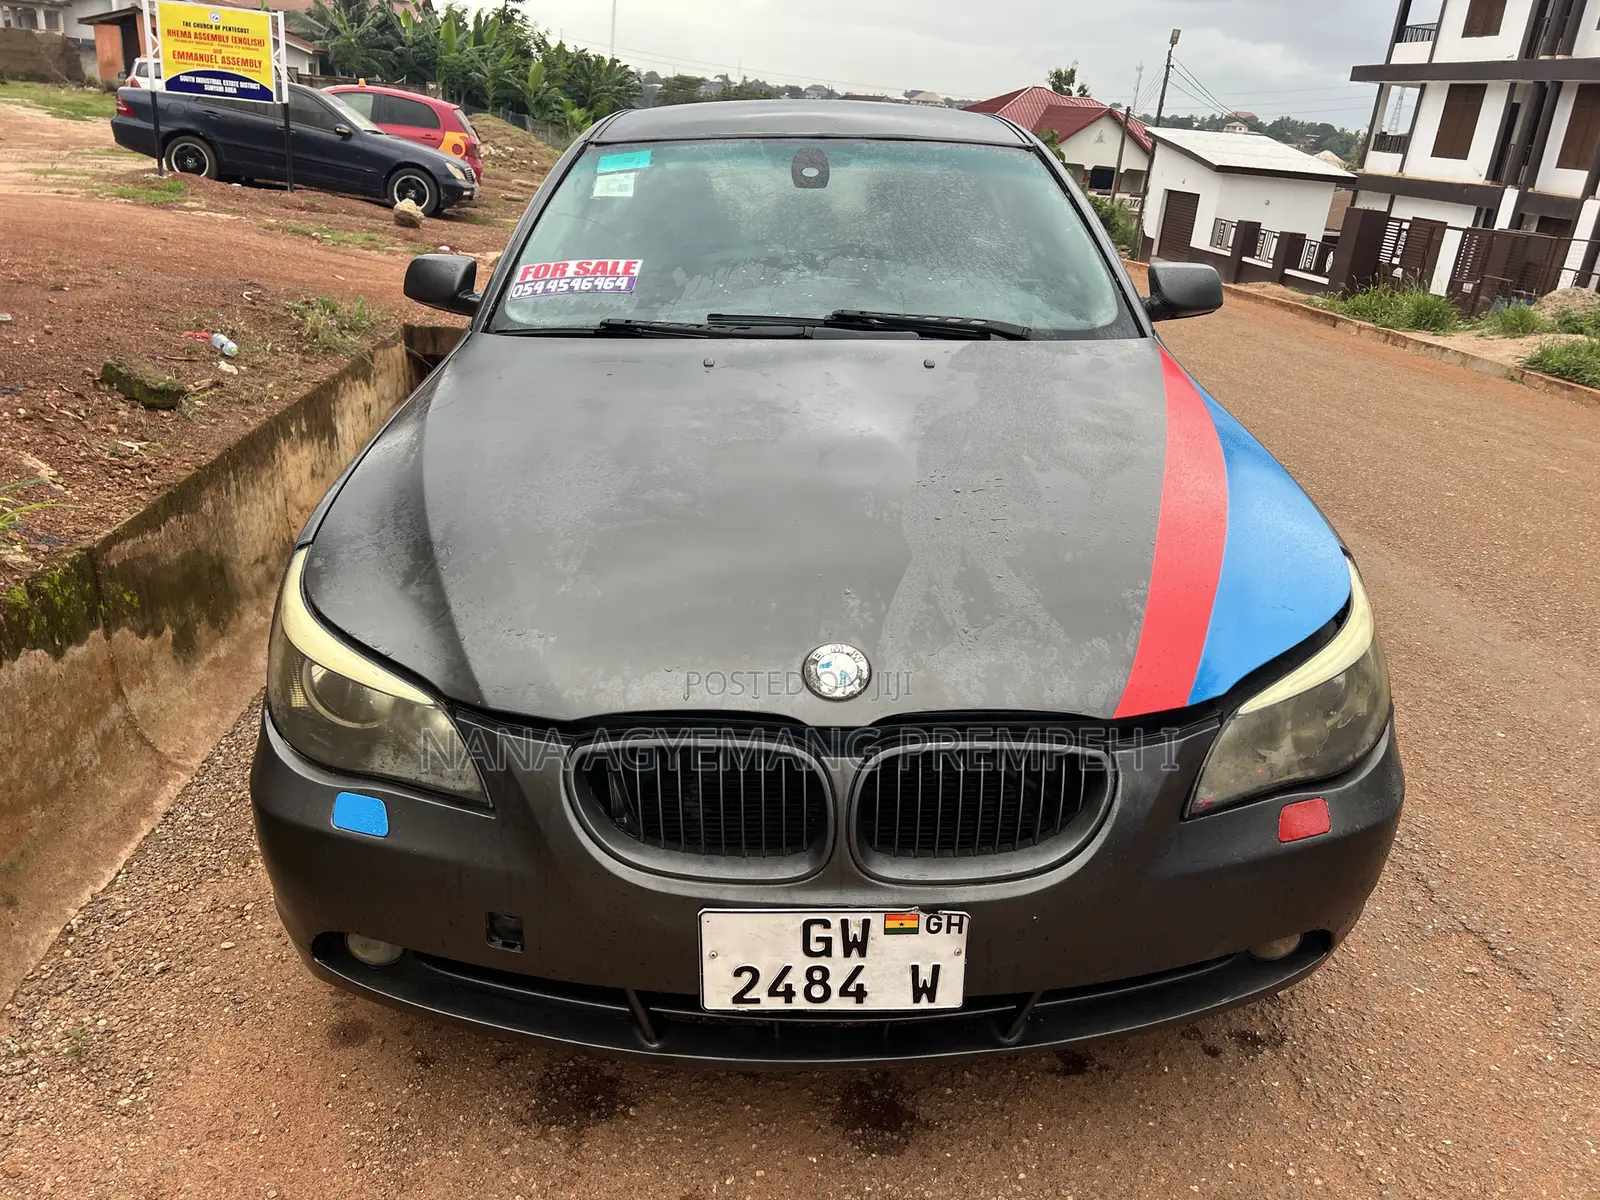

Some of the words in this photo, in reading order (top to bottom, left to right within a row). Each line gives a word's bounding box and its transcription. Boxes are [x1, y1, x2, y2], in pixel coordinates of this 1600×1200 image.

[166, 28, 192, 39] RHEMA
[193, 31, 229, 43] ASSEMBLY
[231, 34, 265, 47] (ENGLISH)
[193, 22, 213, 30] CHURCH
[222, 25, 249, 34] PENTECOST
[172, 50, 219, 64] EMMANUEL
[221, 56, 262, 68] ASSEMBLY
[180, 74, 195, 83] SOUTH
[195, 76, 222, 85] INDUSTRIAL
[223, 79, 239, 88] ESTATE
[240, 81, 260, 90] DISTRICT
[519, 262, 569, 282] FOR
[574, 260, 639, 277] SALE
[811, 643, 864, 662] BMW
[802, 918, 871, 958] GW
[925, 915, 964, 935] GH
[731, 965, 868, 1004] 2484
[911, 964, 941, 1004] W
